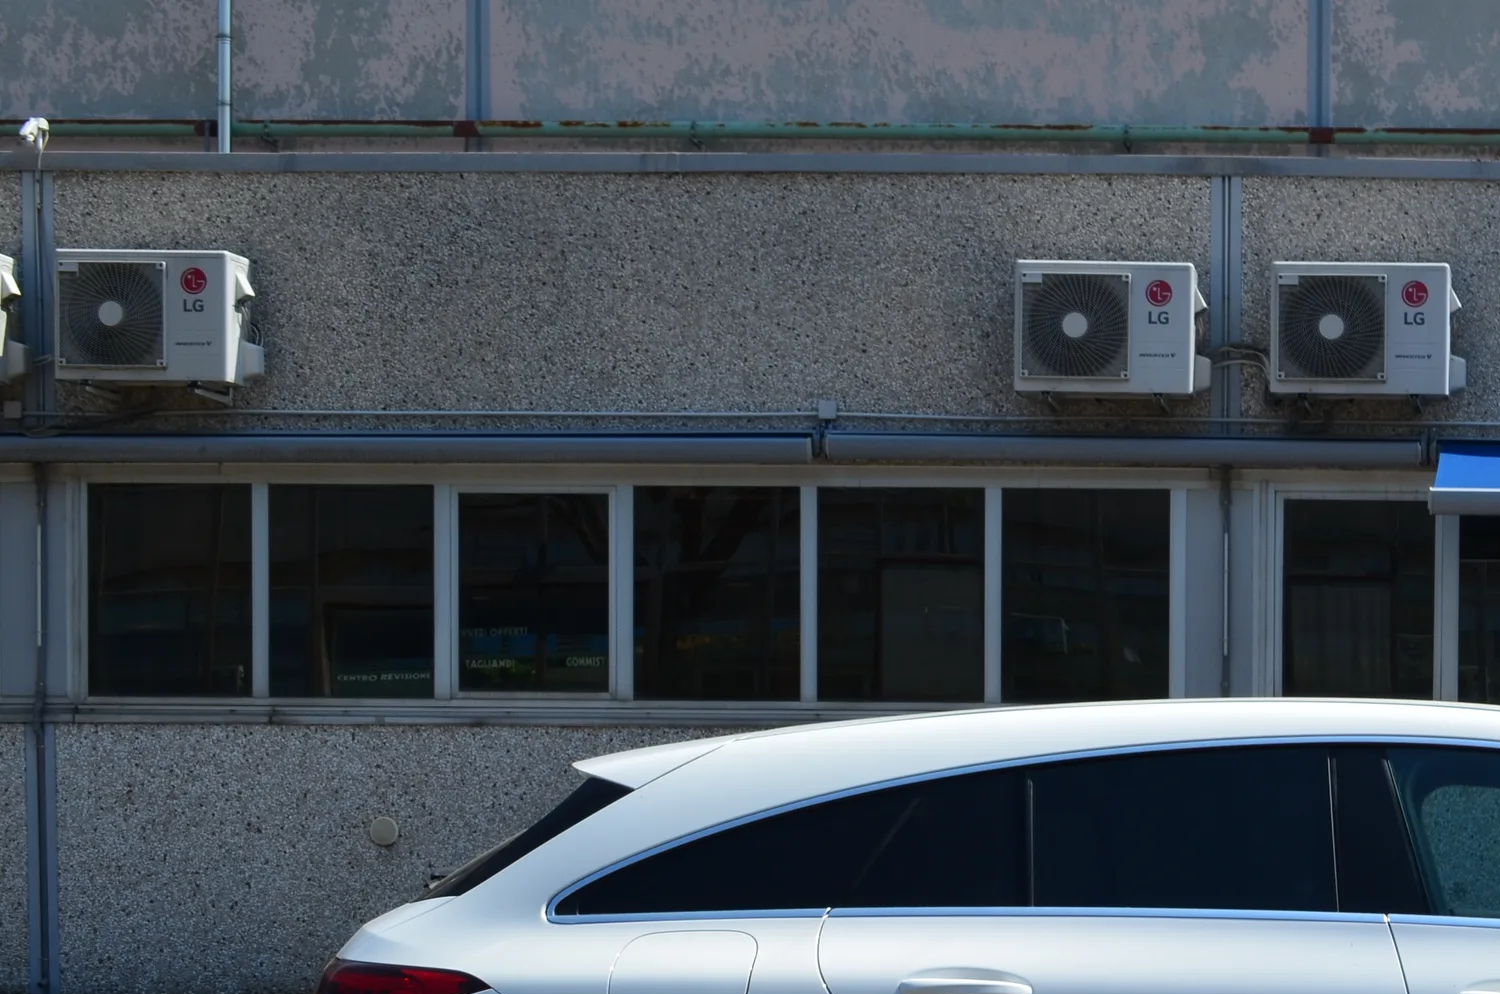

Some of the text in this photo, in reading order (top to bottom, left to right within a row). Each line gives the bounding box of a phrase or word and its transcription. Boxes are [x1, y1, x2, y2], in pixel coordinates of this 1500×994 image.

[183, 298, 204, 313] LG
[1148, 310, 1169, 325] LG
[1404, 311, 1425, 326] LG
[465, 658, 516, 670] TAGLIANDI
[336, 672, 431, 682] CENTRO REVISIONE
